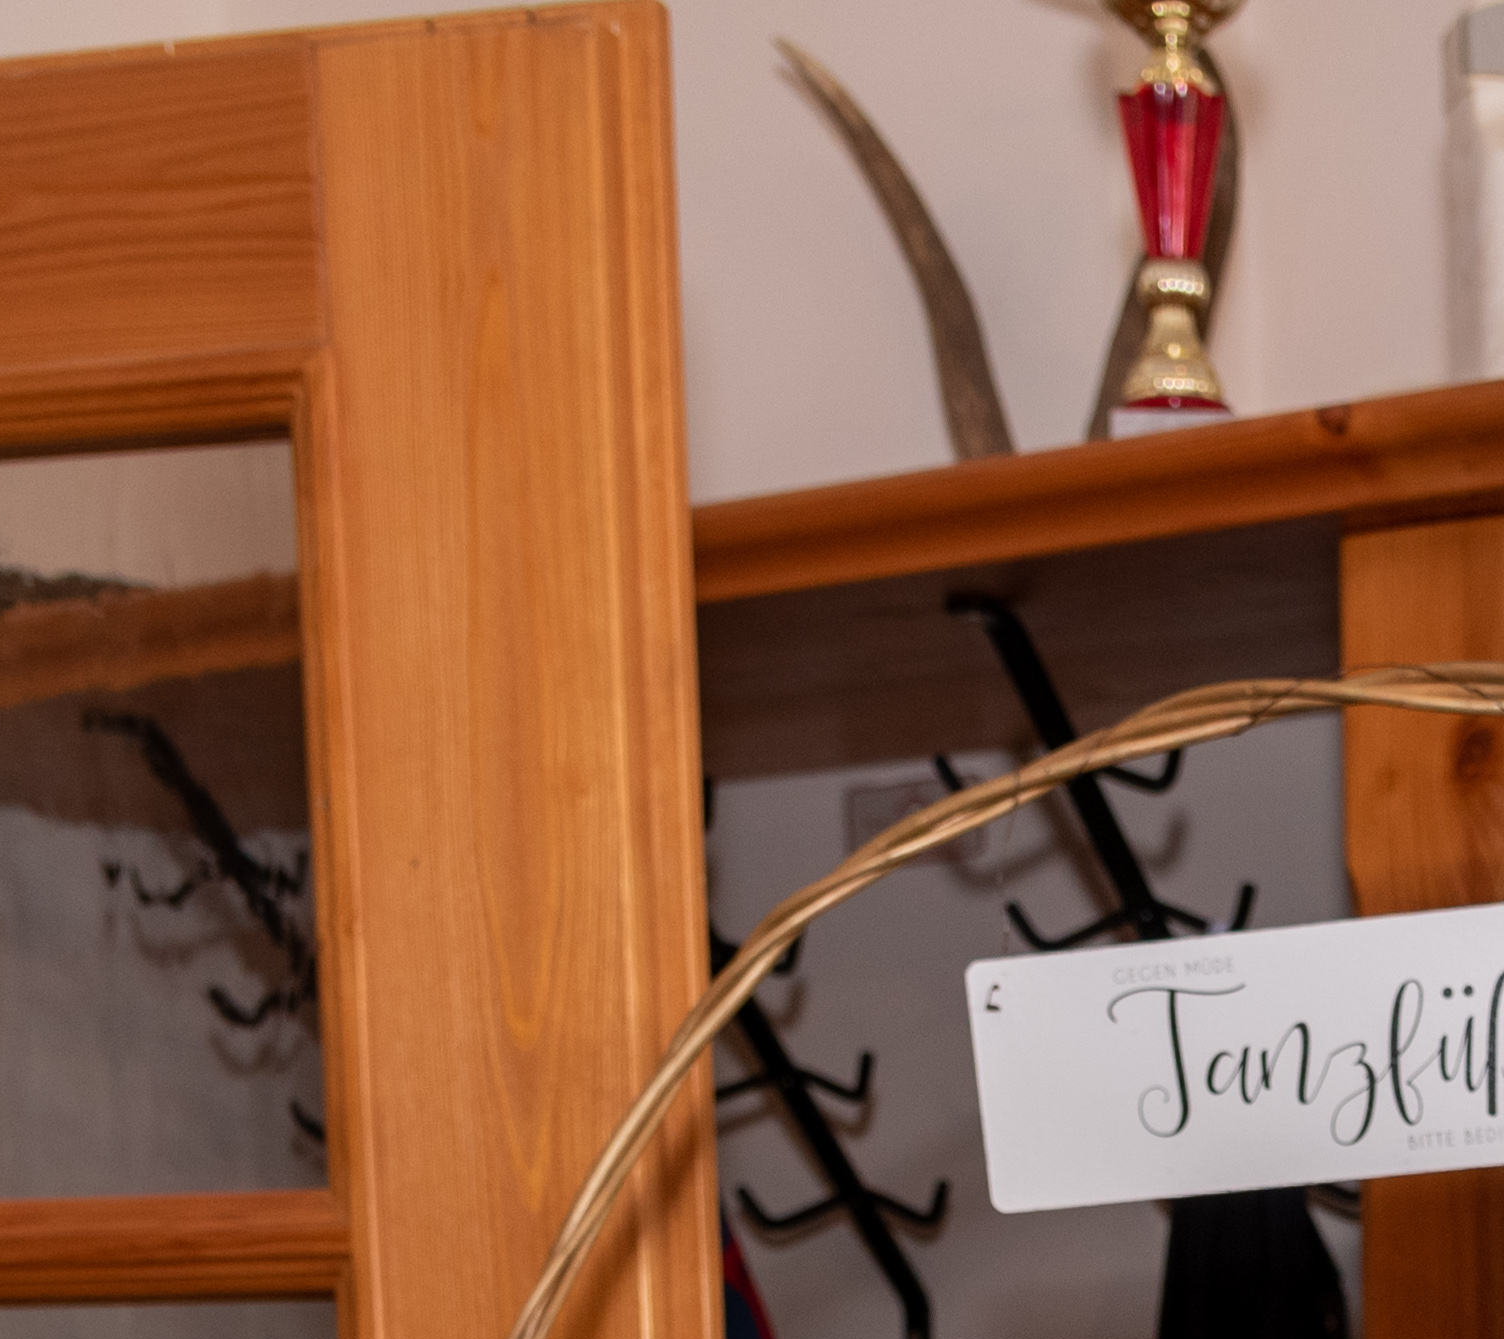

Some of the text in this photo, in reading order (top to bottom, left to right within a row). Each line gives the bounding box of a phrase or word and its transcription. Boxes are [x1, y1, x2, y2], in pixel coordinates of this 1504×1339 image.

[1111, 956, 1235, 985] GEGEN MÜDE
[1407, 1130, 1455, 1150] BITTE
